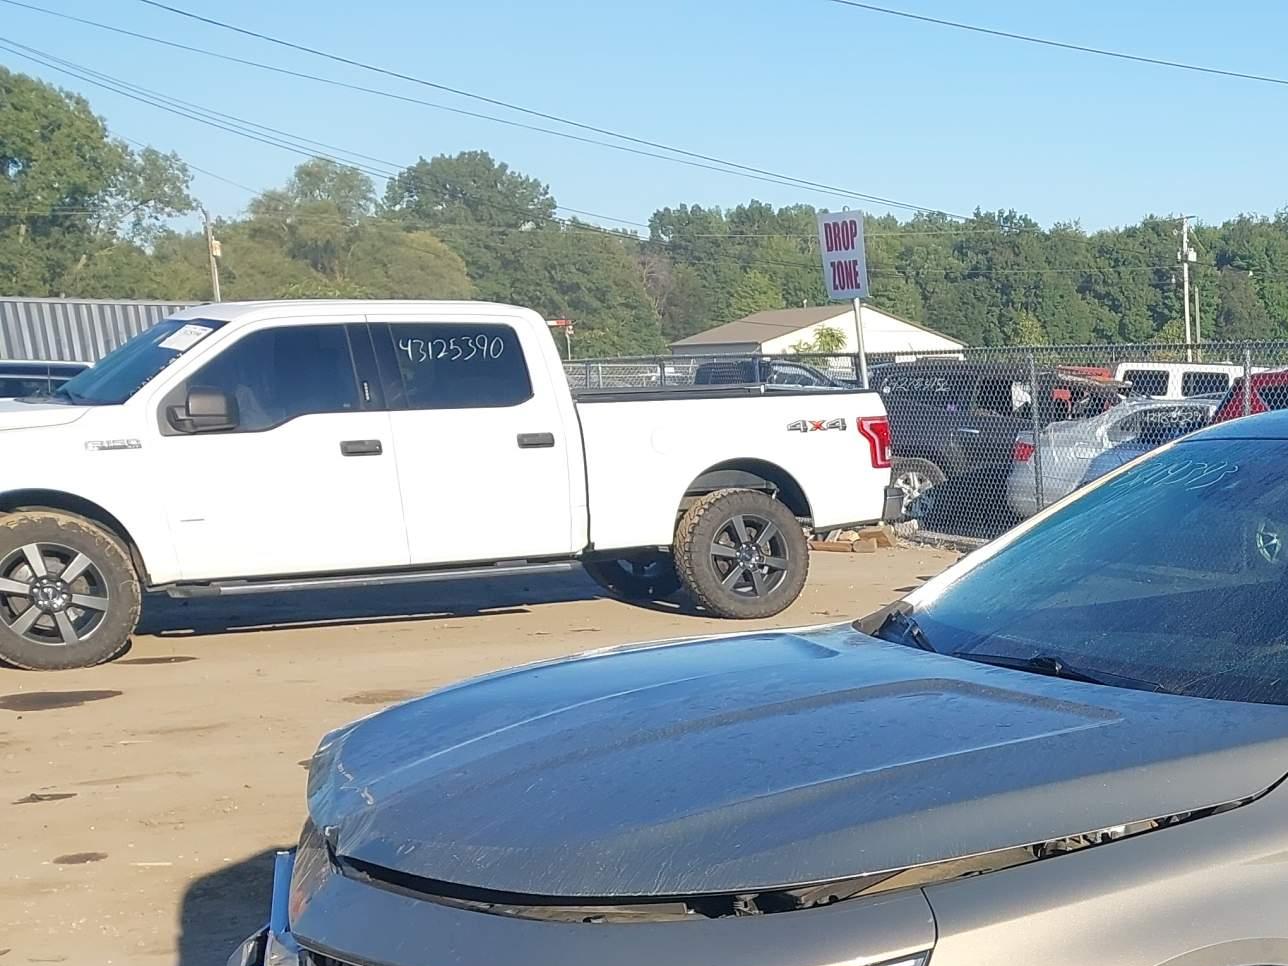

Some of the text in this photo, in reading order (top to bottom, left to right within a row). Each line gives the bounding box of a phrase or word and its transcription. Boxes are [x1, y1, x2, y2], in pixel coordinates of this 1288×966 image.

[823, 219, 858, 253] DROP
[829, 258, 862, 292] ZONE
[398, 333, 505, 363] 43125390
